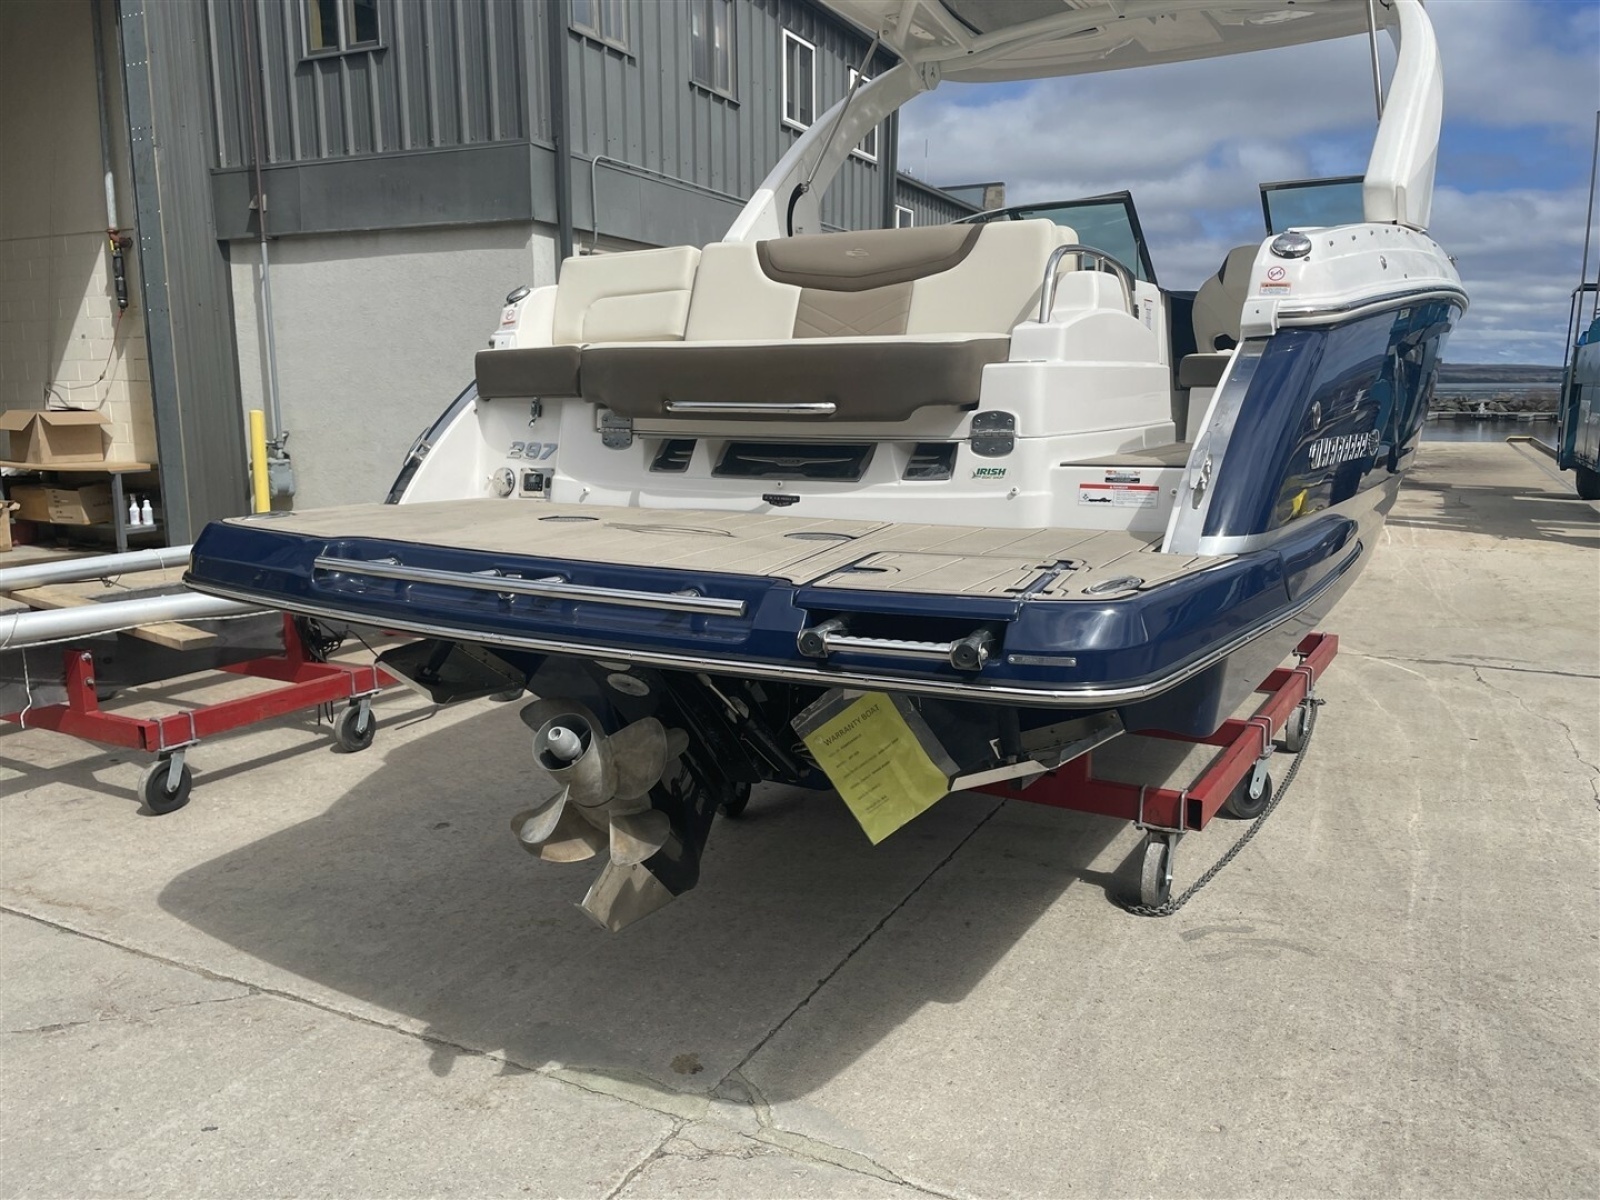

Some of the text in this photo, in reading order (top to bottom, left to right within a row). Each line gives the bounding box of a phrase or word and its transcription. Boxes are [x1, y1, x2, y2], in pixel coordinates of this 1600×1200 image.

[507, 441, 559, 460] 297
[976, 468, 1007, 476] IRISH
[823, 716, 862, 747] WARRANTY
[861, 703, 881, 721] BOAT
